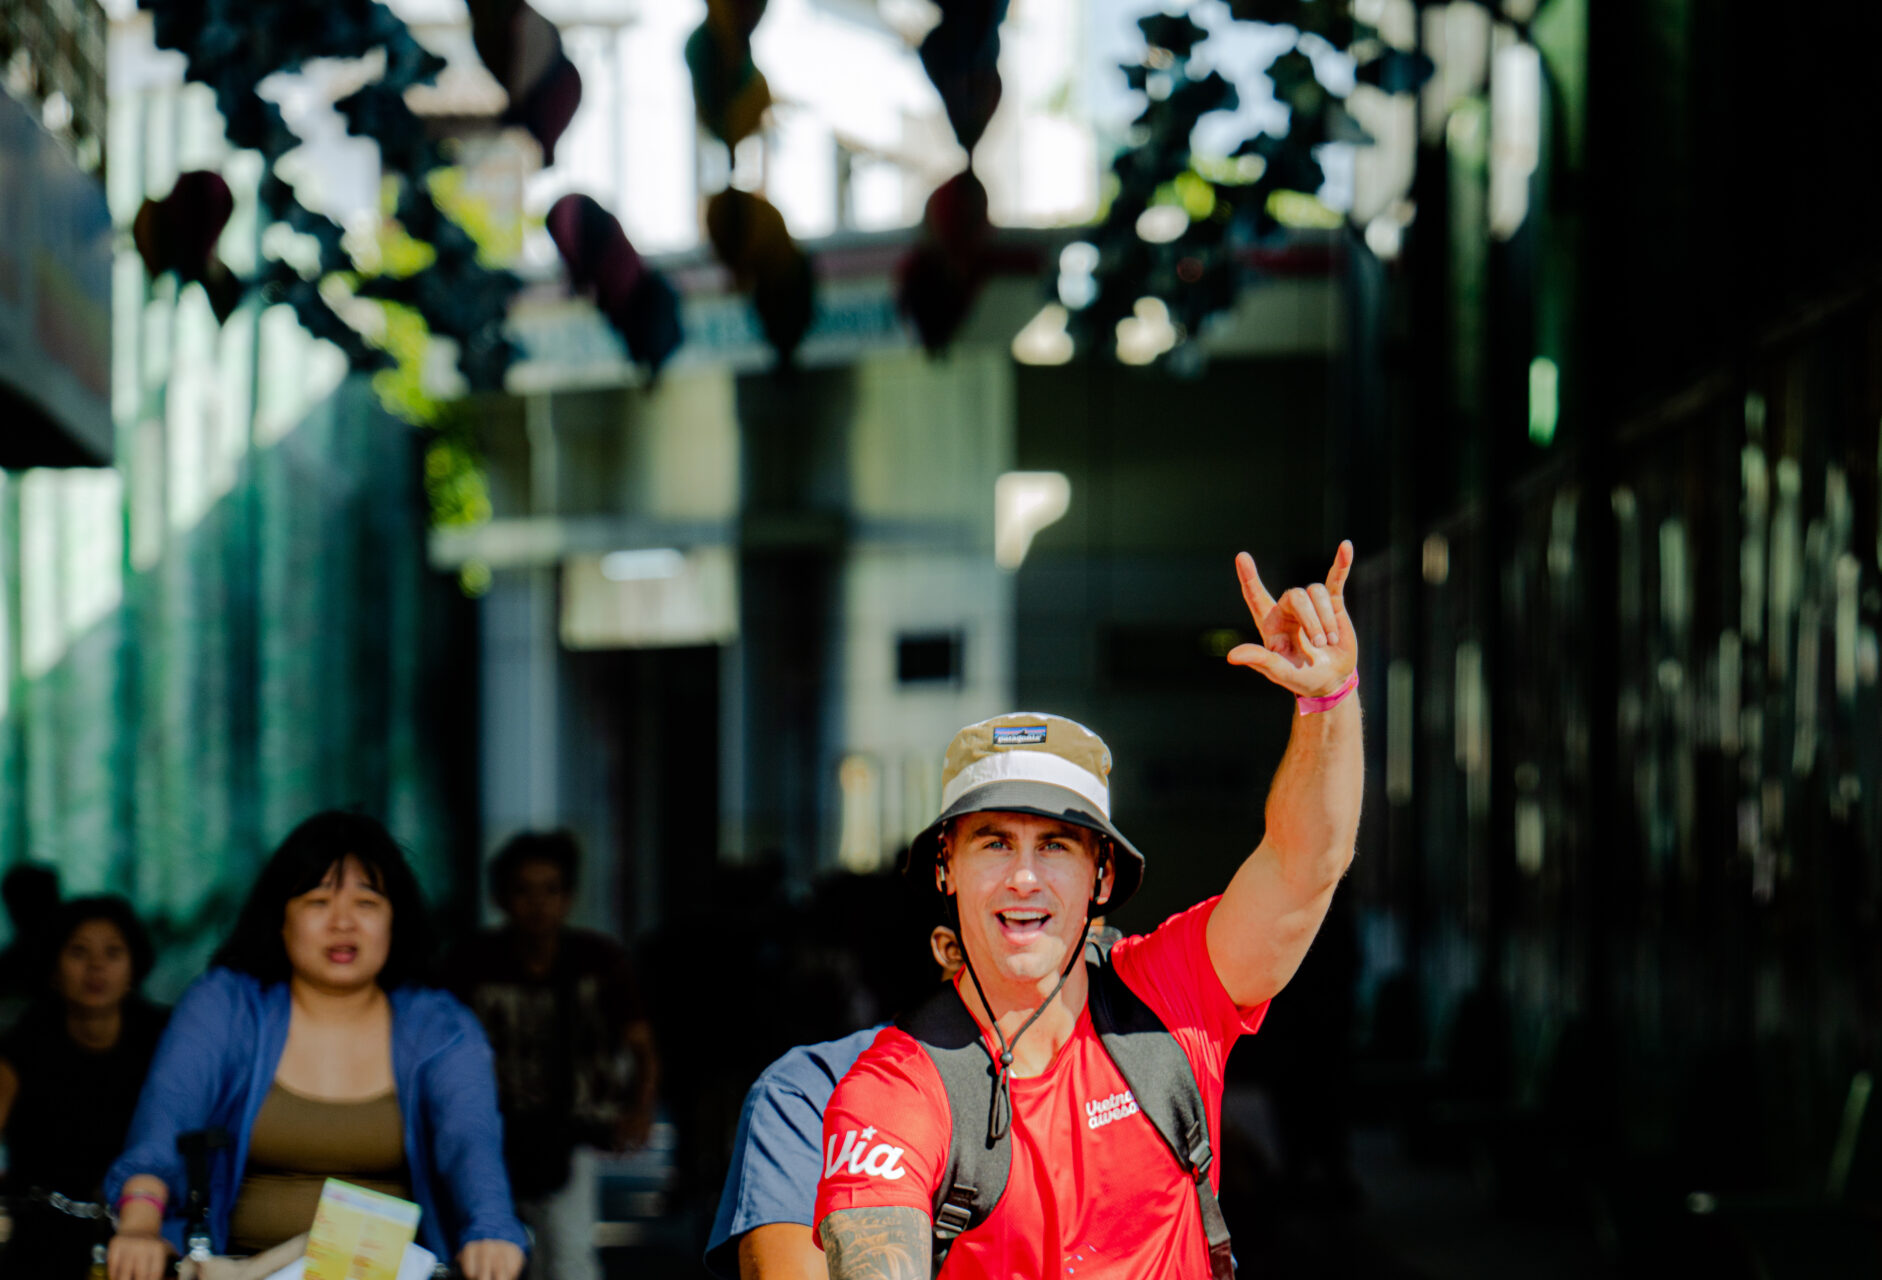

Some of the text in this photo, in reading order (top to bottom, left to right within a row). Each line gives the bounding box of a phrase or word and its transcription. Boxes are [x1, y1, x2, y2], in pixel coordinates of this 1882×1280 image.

[1085, 1089, 1135, 1117] Vietna
[1088, 1102, 1140, 1130] aweso
[824, 1125, 906, 1180] Via
